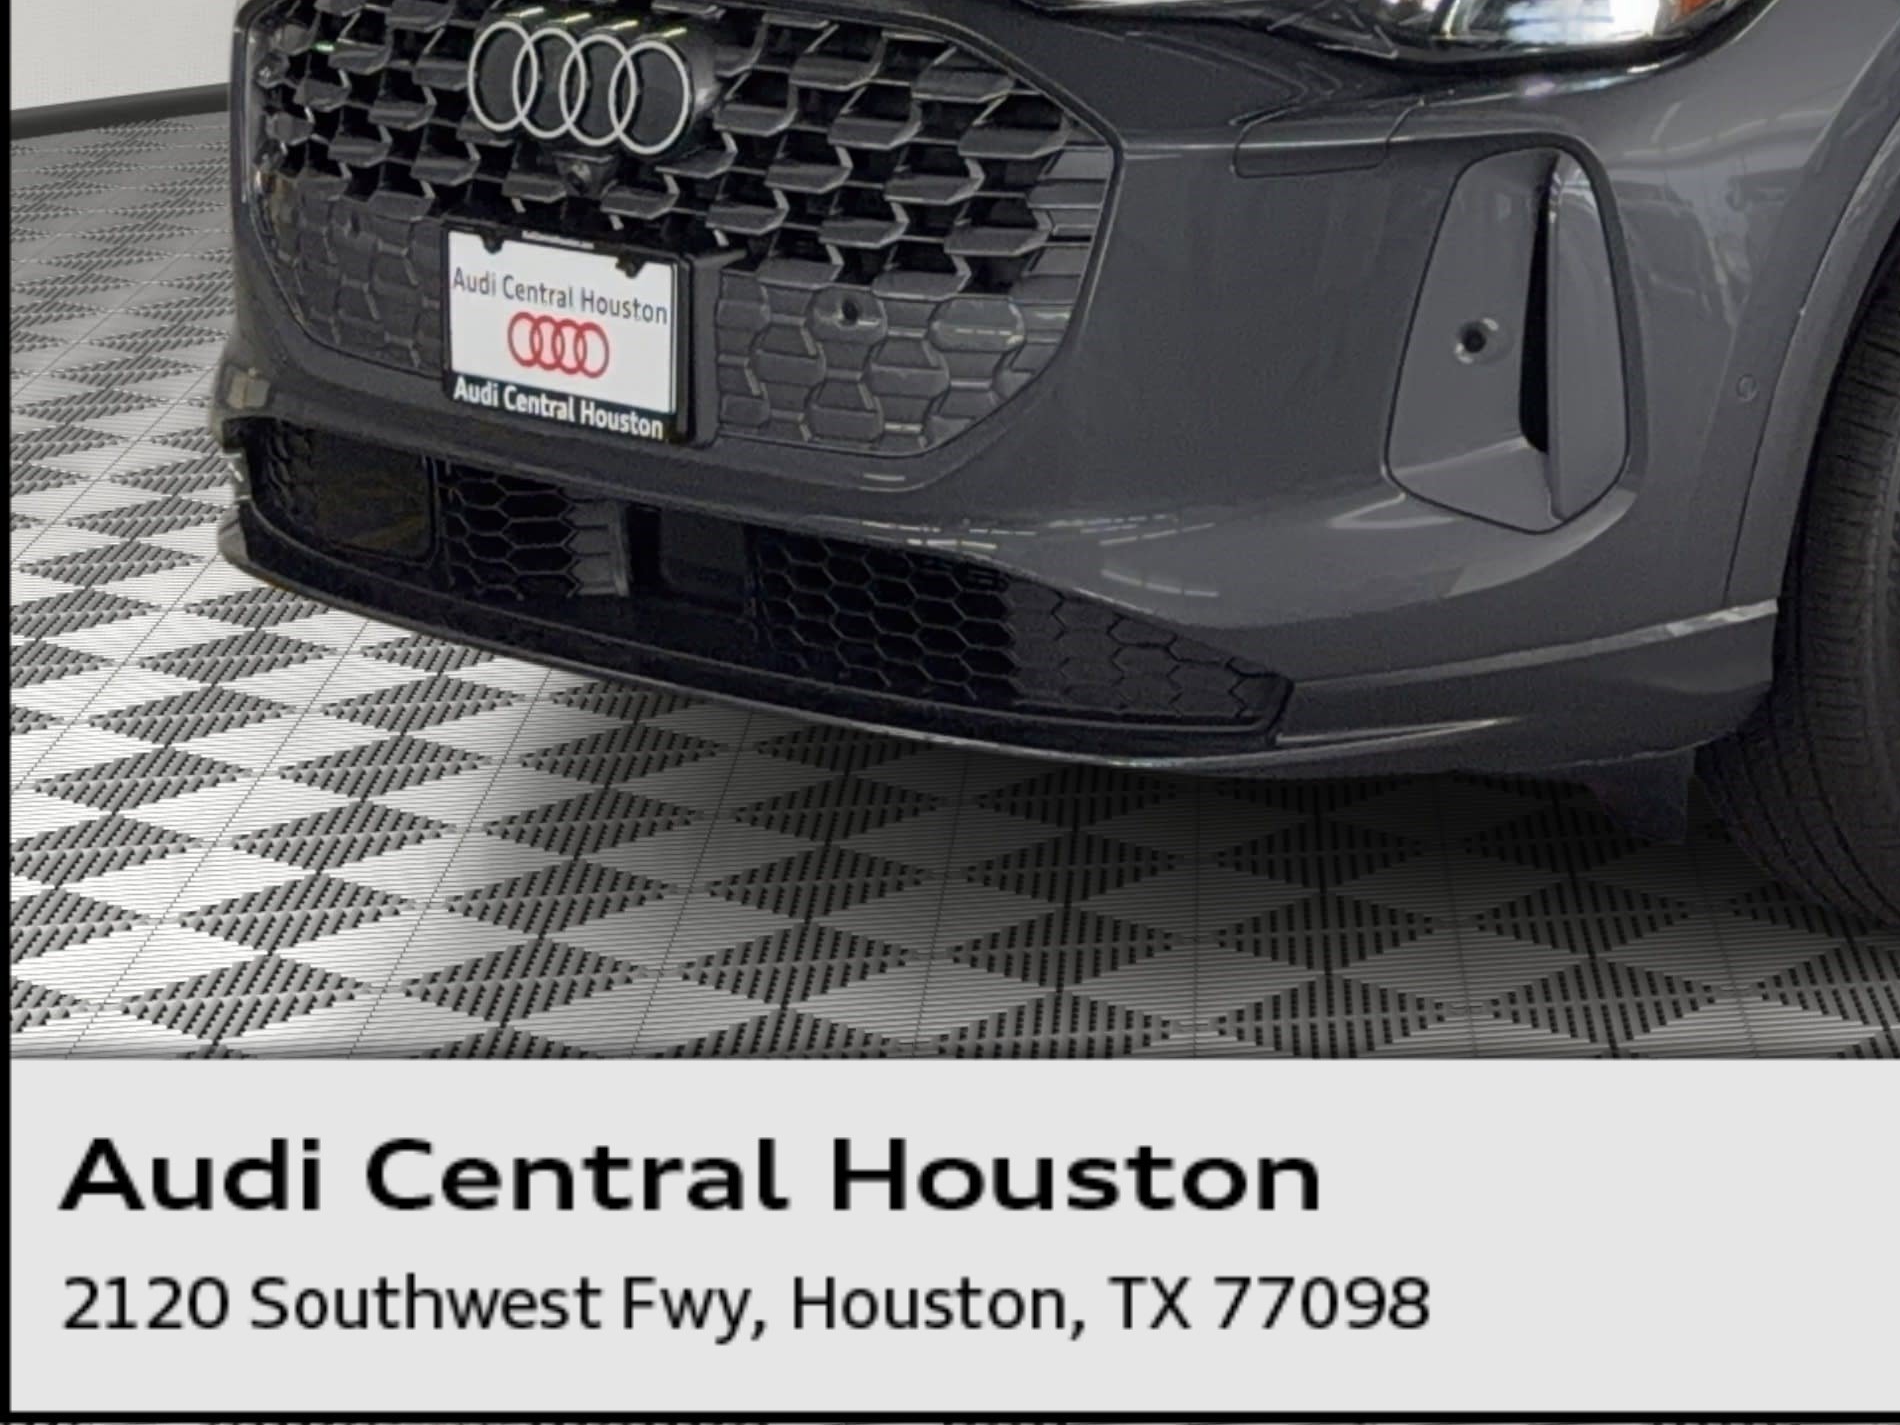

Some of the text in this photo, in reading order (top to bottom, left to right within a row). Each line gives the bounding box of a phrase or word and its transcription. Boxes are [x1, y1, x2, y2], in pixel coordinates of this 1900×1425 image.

[453, 266, 668, 325] Audi Central Houston
[453, 376, 664, 441] Audi Central Houston
